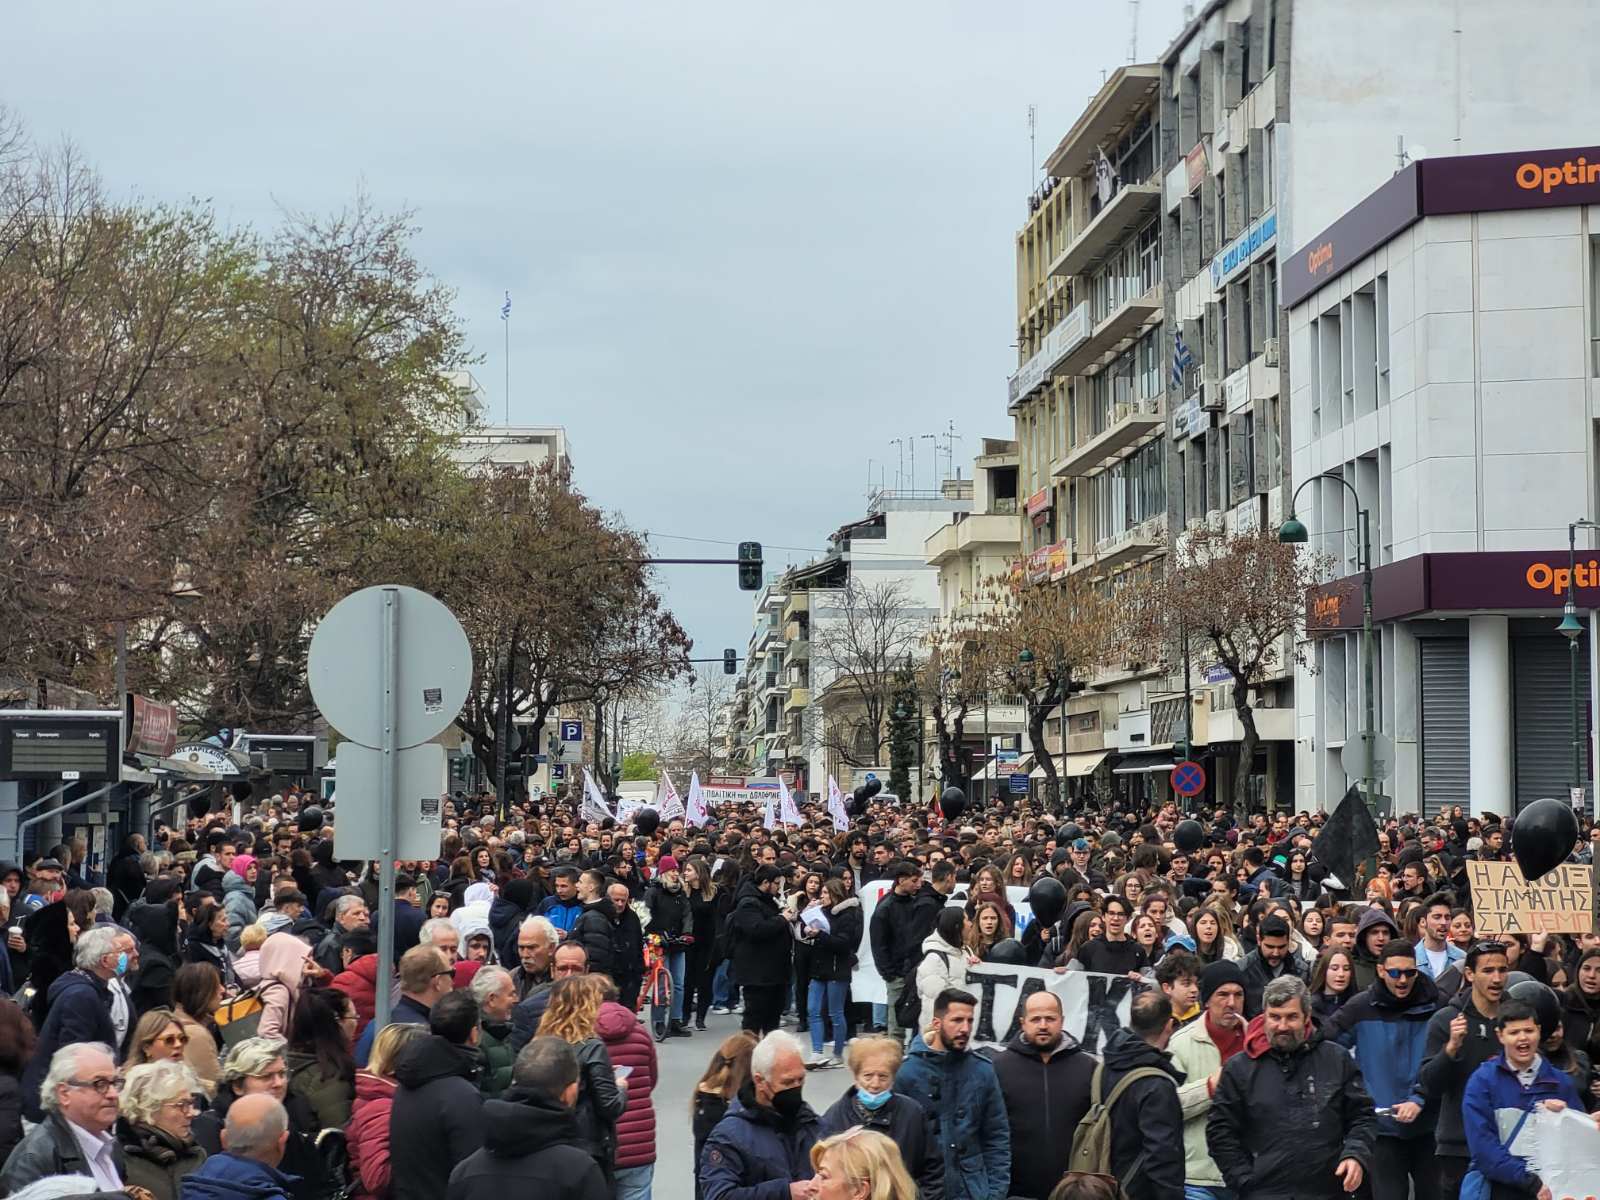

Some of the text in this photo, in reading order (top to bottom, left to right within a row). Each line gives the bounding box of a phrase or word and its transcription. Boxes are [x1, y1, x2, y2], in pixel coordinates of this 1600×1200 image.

[1474, 864, 1491, 886] Η
[1474, 888, 1593, 911] ΣΤΑΜΑΤΗΣ
[1477, 912, 1522, 932] ΣΤΑ
